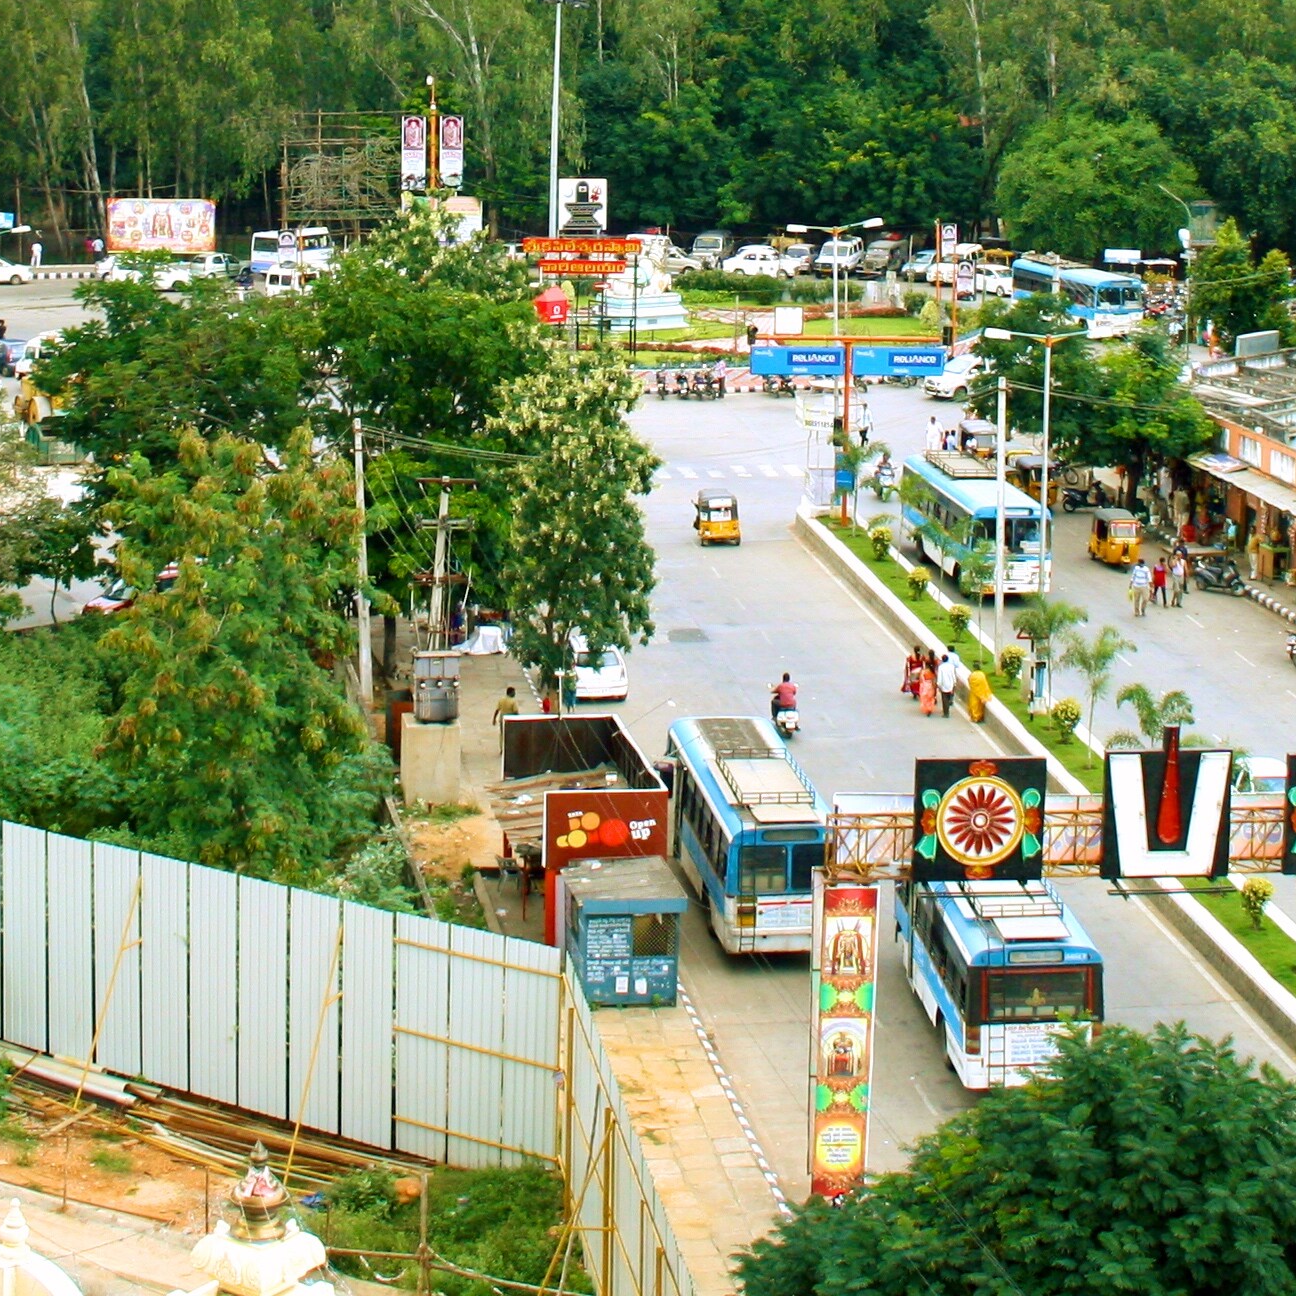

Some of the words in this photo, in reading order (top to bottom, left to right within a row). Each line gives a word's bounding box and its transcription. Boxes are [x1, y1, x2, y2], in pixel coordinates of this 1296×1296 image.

[792, 353, 836, 363] RELIANCE
[893, 354, 937, 364] RELIANCE
[629, 818, 657, 830] Open
[630, 827, 651, 841] up
